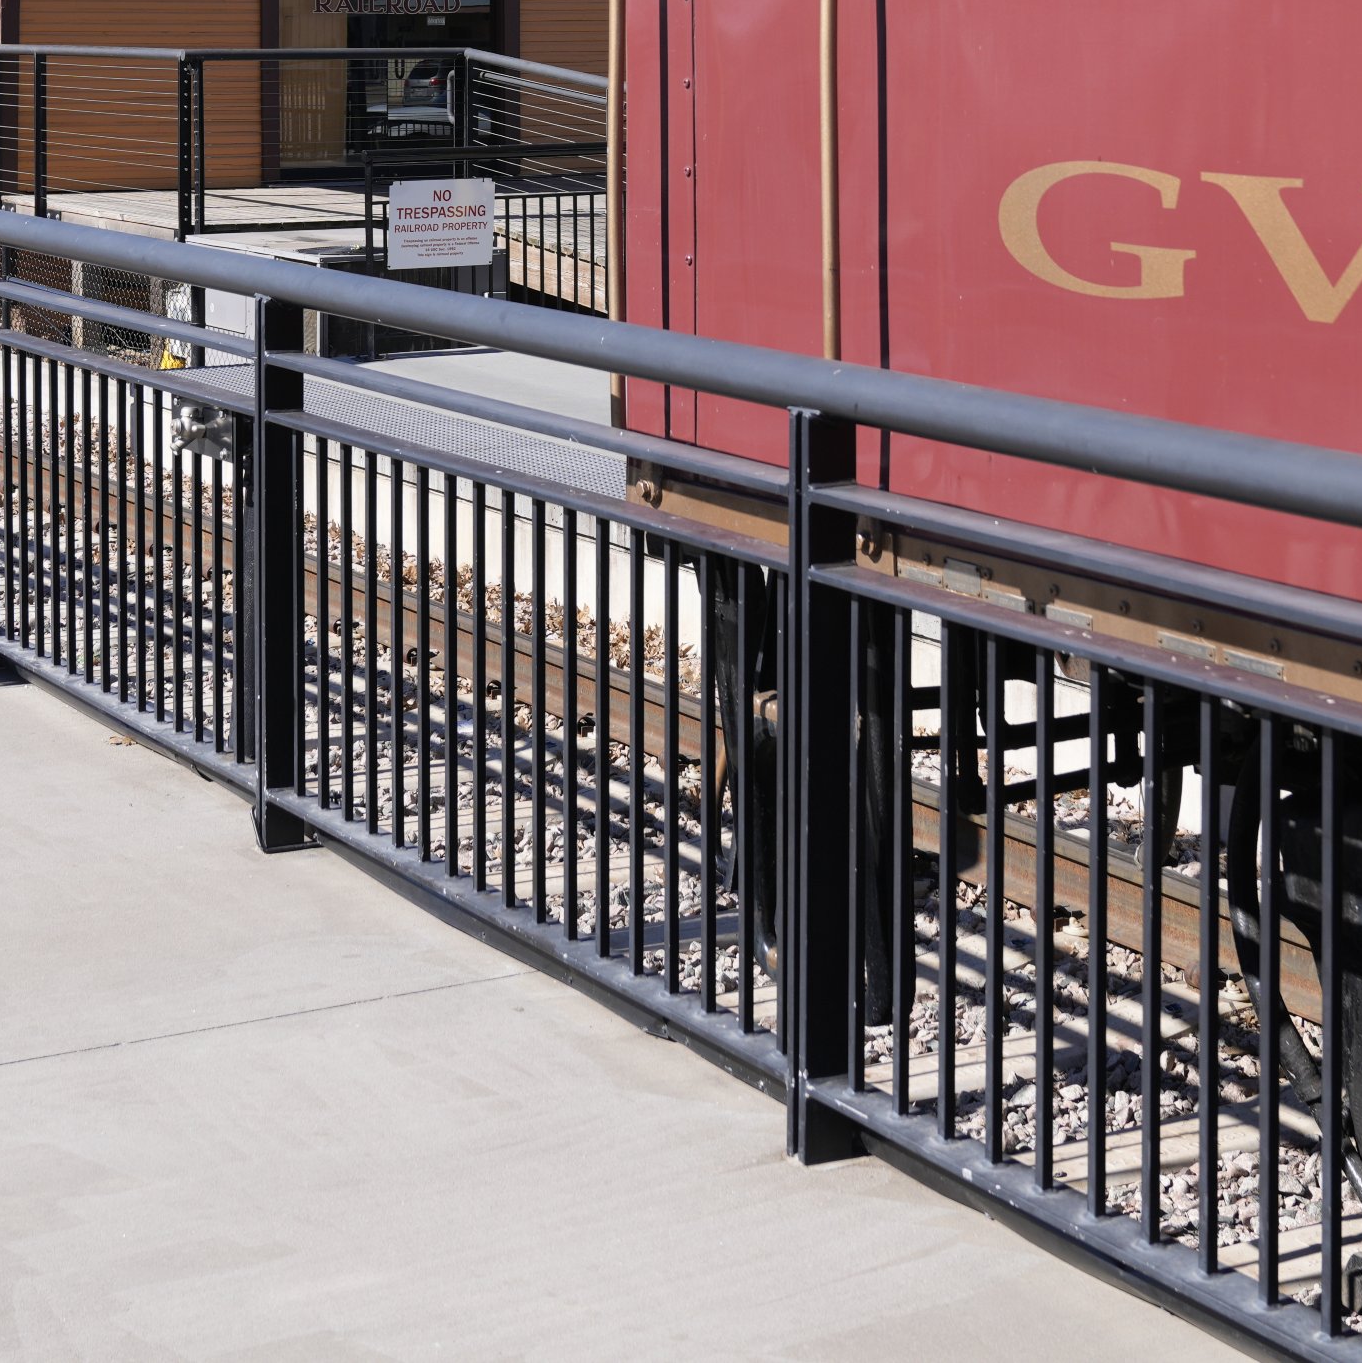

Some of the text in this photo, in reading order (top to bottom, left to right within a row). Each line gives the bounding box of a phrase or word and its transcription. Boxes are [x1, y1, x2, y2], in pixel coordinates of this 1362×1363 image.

[433, 189, 452, 202] NO
[396, 204, 486, 220] TRESPASSING
[394, 221, 488, 233] RAILROAD PROPERTY
